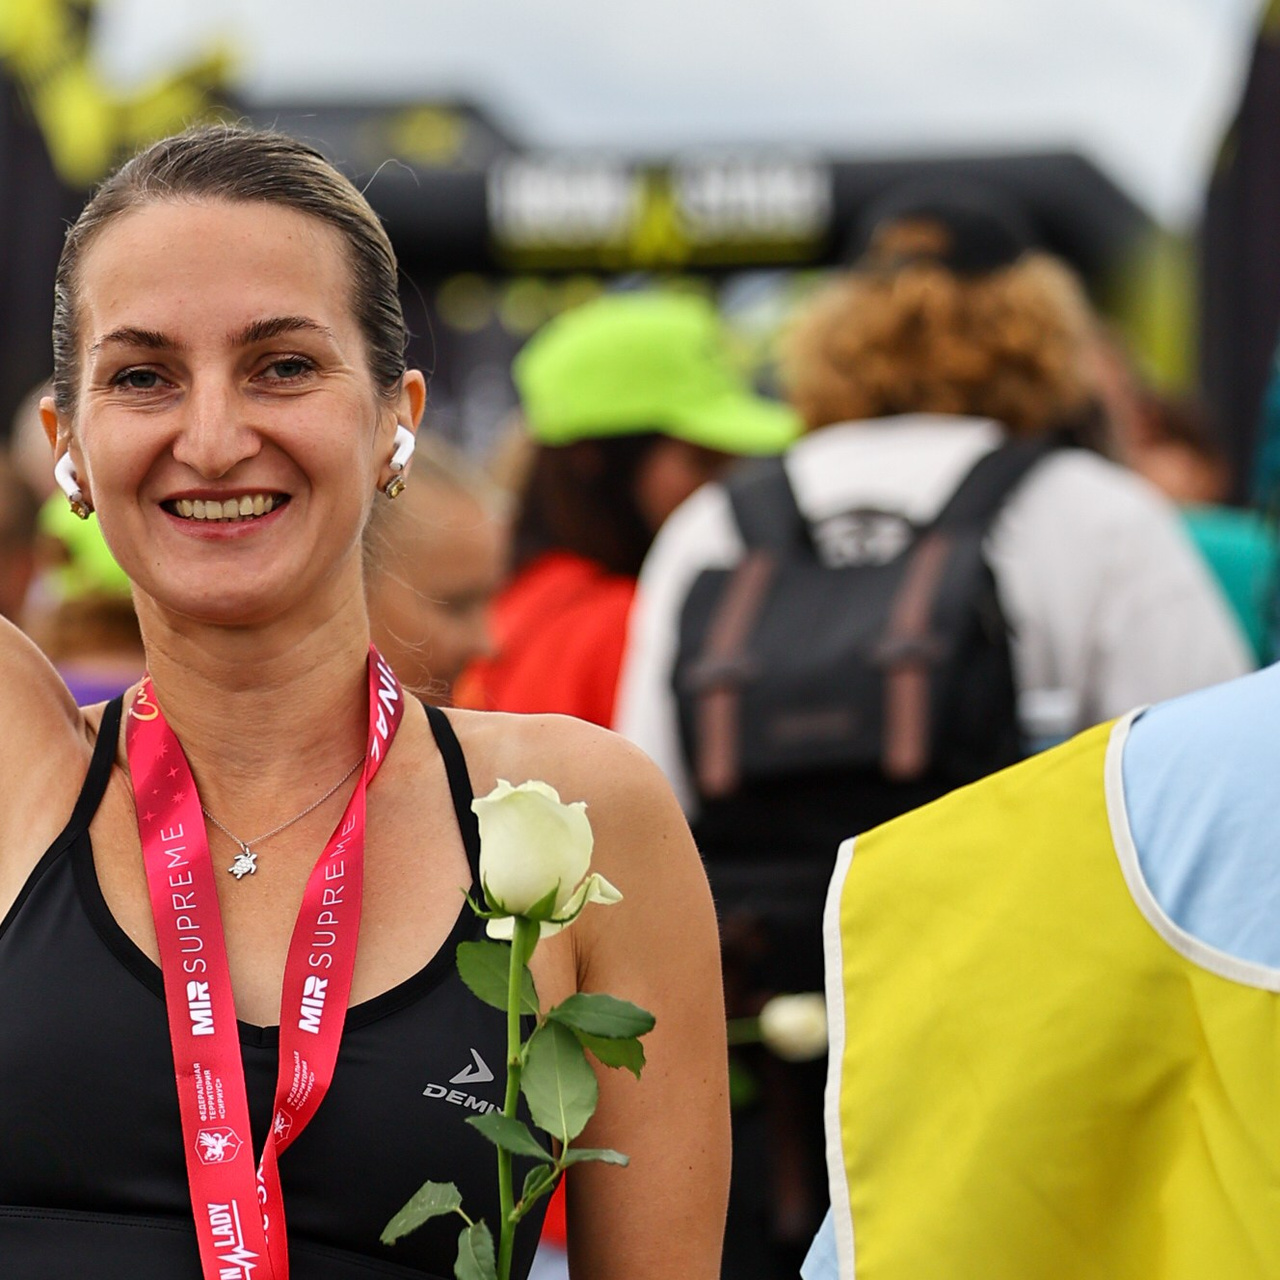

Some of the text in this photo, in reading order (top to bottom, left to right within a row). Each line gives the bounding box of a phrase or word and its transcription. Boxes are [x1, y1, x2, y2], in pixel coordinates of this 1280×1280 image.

[371, 653, 399, 762] INAL
[160, 823, 215, 1036] MIR SUPREME
[298, 815, 356, 1034] MIR SUPREME
[193, 1062, 207, 1122] ФЕДЕРАЛЬНАЯ
[203, 1069, 216, 1121] ТЕРРИТОРИЯ
[215, 1078, 225, 1119] «СИРИУС»
[287, 1050, 300, 1104] ФЕДЕРАЛЬНАЯ
[291, 1060, 307, 1107] ТЕРРИТОРИЯ
[207, 1203, 236, 1248] LADY
